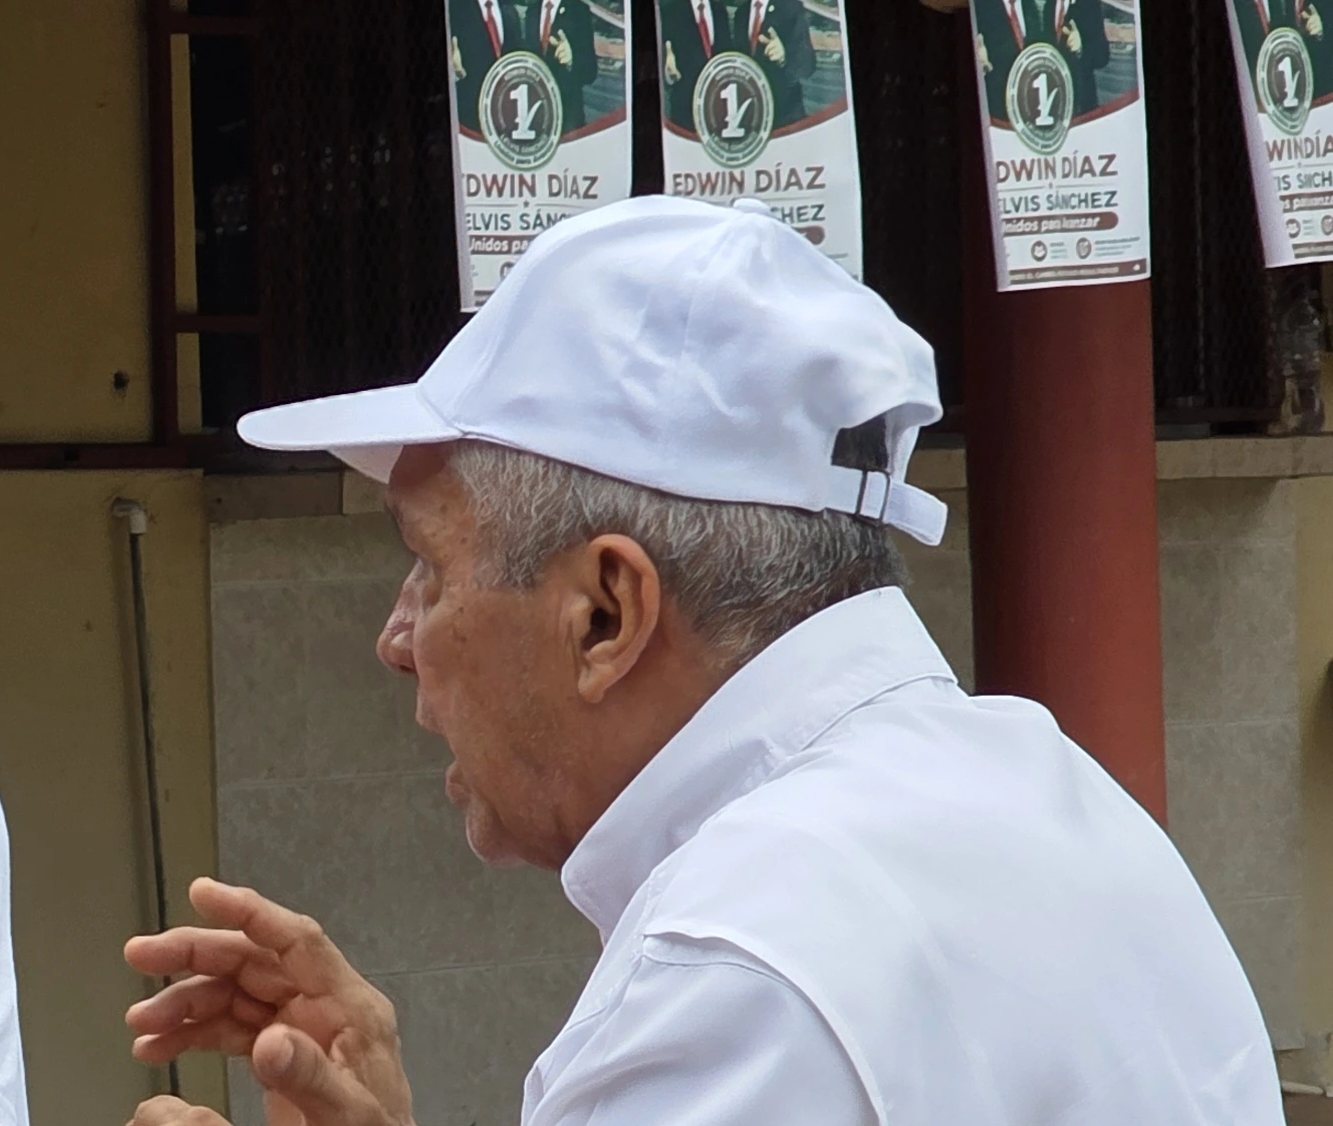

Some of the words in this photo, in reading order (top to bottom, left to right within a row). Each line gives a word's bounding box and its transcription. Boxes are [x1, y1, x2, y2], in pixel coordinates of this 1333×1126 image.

[1278, 56, 1299, 107] 1
[510, 84, 536, 140] 1
[720, 83, 745, 138] 1
[1032, 73, 1054, 126] 1
[1265, 138, 1303, 162] WIN
[1304, 129, 1333, 159] DÍA
[672, 170, 745, 197] EDWIN
[754, 162, 826, 194] DÍAZ
[996, 156, 1057, 183] DWIN
[1061, 150, 1118, 179] DÍAZ
[463, 174, 537, 198] DWIN
[548, 168, 599, 200] DÍAZ
[1046, 190, 1118, 211] SÁNCHEZ
[466, 213, 511, 231] ELVIS
[512, 240, 528, 254] pa
